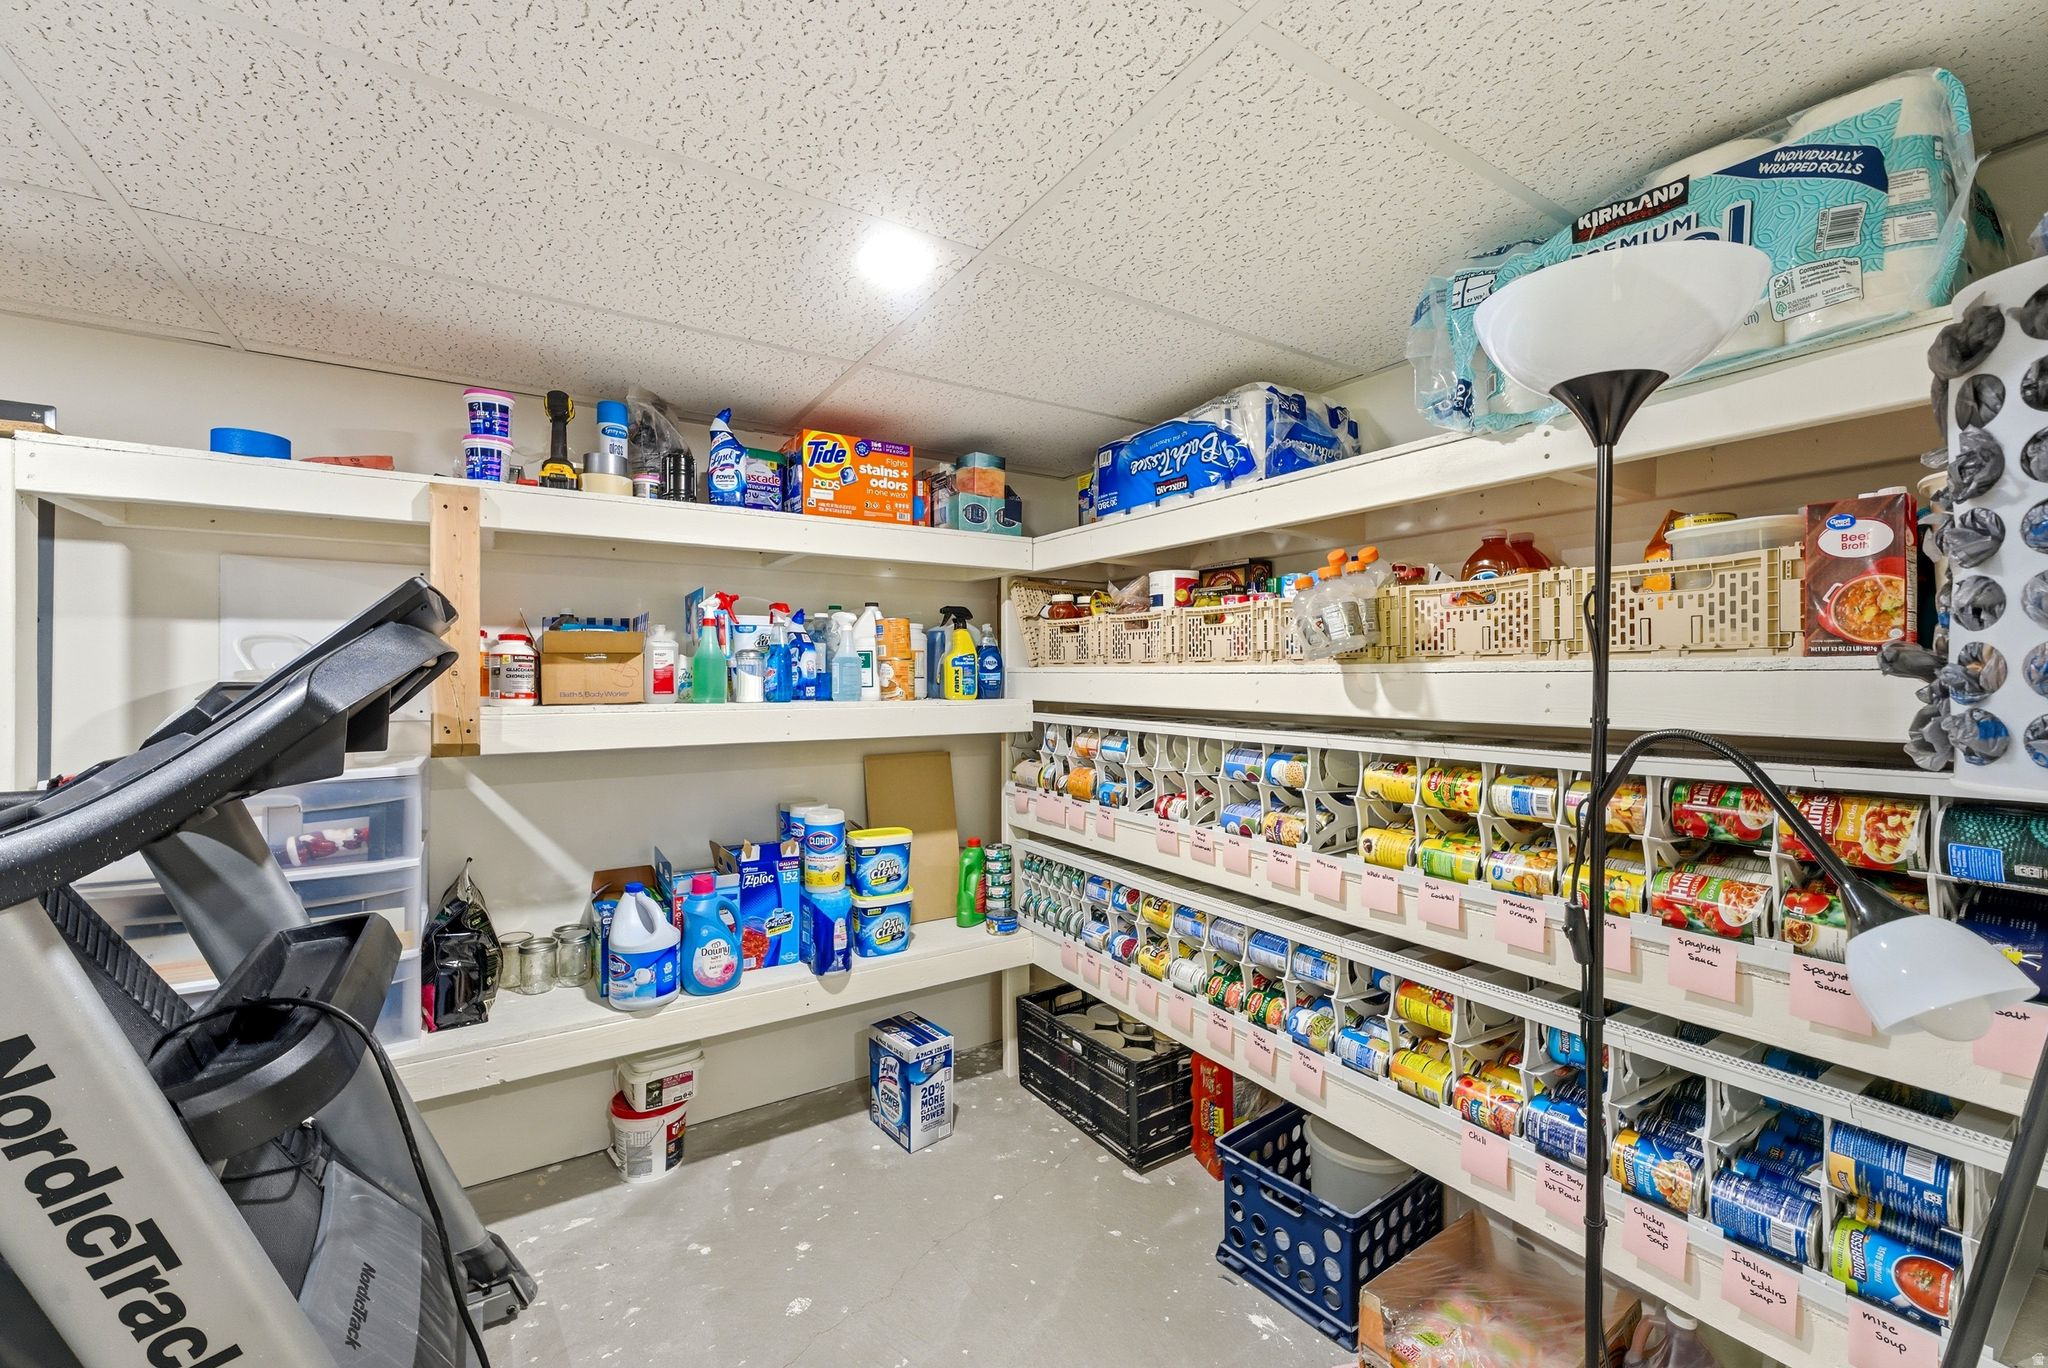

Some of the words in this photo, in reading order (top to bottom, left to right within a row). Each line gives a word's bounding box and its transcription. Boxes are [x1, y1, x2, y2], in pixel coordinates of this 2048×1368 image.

[1773, 149, 1864, 162] INDIVIDUALLY
[1758, 162, 1817, 175] WRAPPED
[1817, 162, 1865, 175] ROLLS
[1577, 182, 1685, 230] KIRKLAND
[1571, 212, 1693, 260] MIUM
[711, 450, 735, 468] Lysol
[807, 440, 847, 468] Tide
[1170, 432, 1220, 473] Bath
[885, 458, 908, 468] Fights
[1130, 448, 1174, 477] Tissue
[859, 463, 900, 478] stains
[900, 470, 909, 478] +
[746, 473, 780, 486] ascade
[812, 478, 841, 490] PODS
[869, 478, 908, 491] odors
[889, 489, 908, 499] wash
[584, 691, 604, 699] Body
[808, 835, 834, 846] CLOROX
[877, 859, 895, 870] OXI
[782, 871, 799, 881] 152
[870, 865, 900, 880] CLEAN
[744, 874, 775, 888] Ziploc
[875, 923, 903, 939] CLEAN
[882, 918, 900, 930] OXI
[701, 945, 730, 957] Downy
[915, 1052, 920, 1060] 4
[920, 1048, 934, 1058] PACK
[920, 1081, 945, 1099] 20%
[881, 1089, 900, 1108] POWER
[920, 1093, 945, 1109] MORE
[920, 1108, 945, 1124] POWER
[1544, 1180, 1557, 1192] Pot
[0, 1031, 243, 1368] NordicTrac
[1852, 1229, 1867, 1282] PROGRESSO
[1731, 1249, 1773, 1281] Italian
[344, 1260, 377, 1351] NordicTrack
